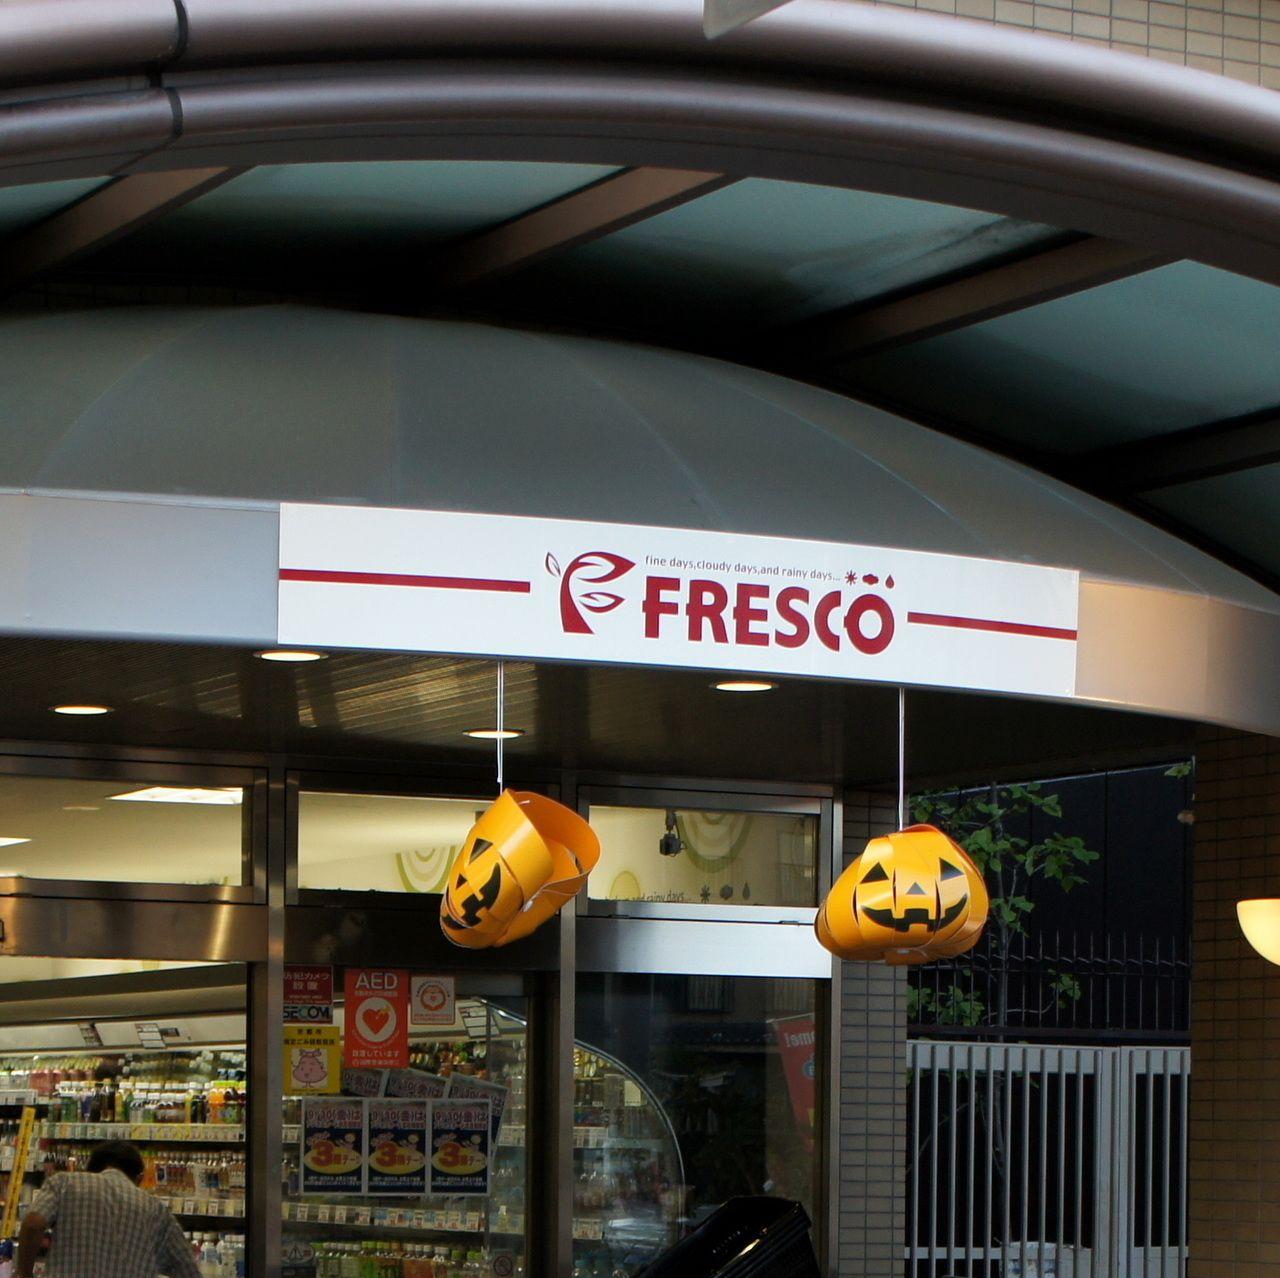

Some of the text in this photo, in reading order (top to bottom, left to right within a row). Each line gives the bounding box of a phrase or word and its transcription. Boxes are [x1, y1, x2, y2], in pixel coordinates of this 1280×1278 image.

[645, 555, 667, 567] fine
[781, 566, 807, 579] rainy
[642, 575, 895, 656] FRESCO
[355, 972, 398, 989] AED
[283, 1006, 330, 1019] SECOM
